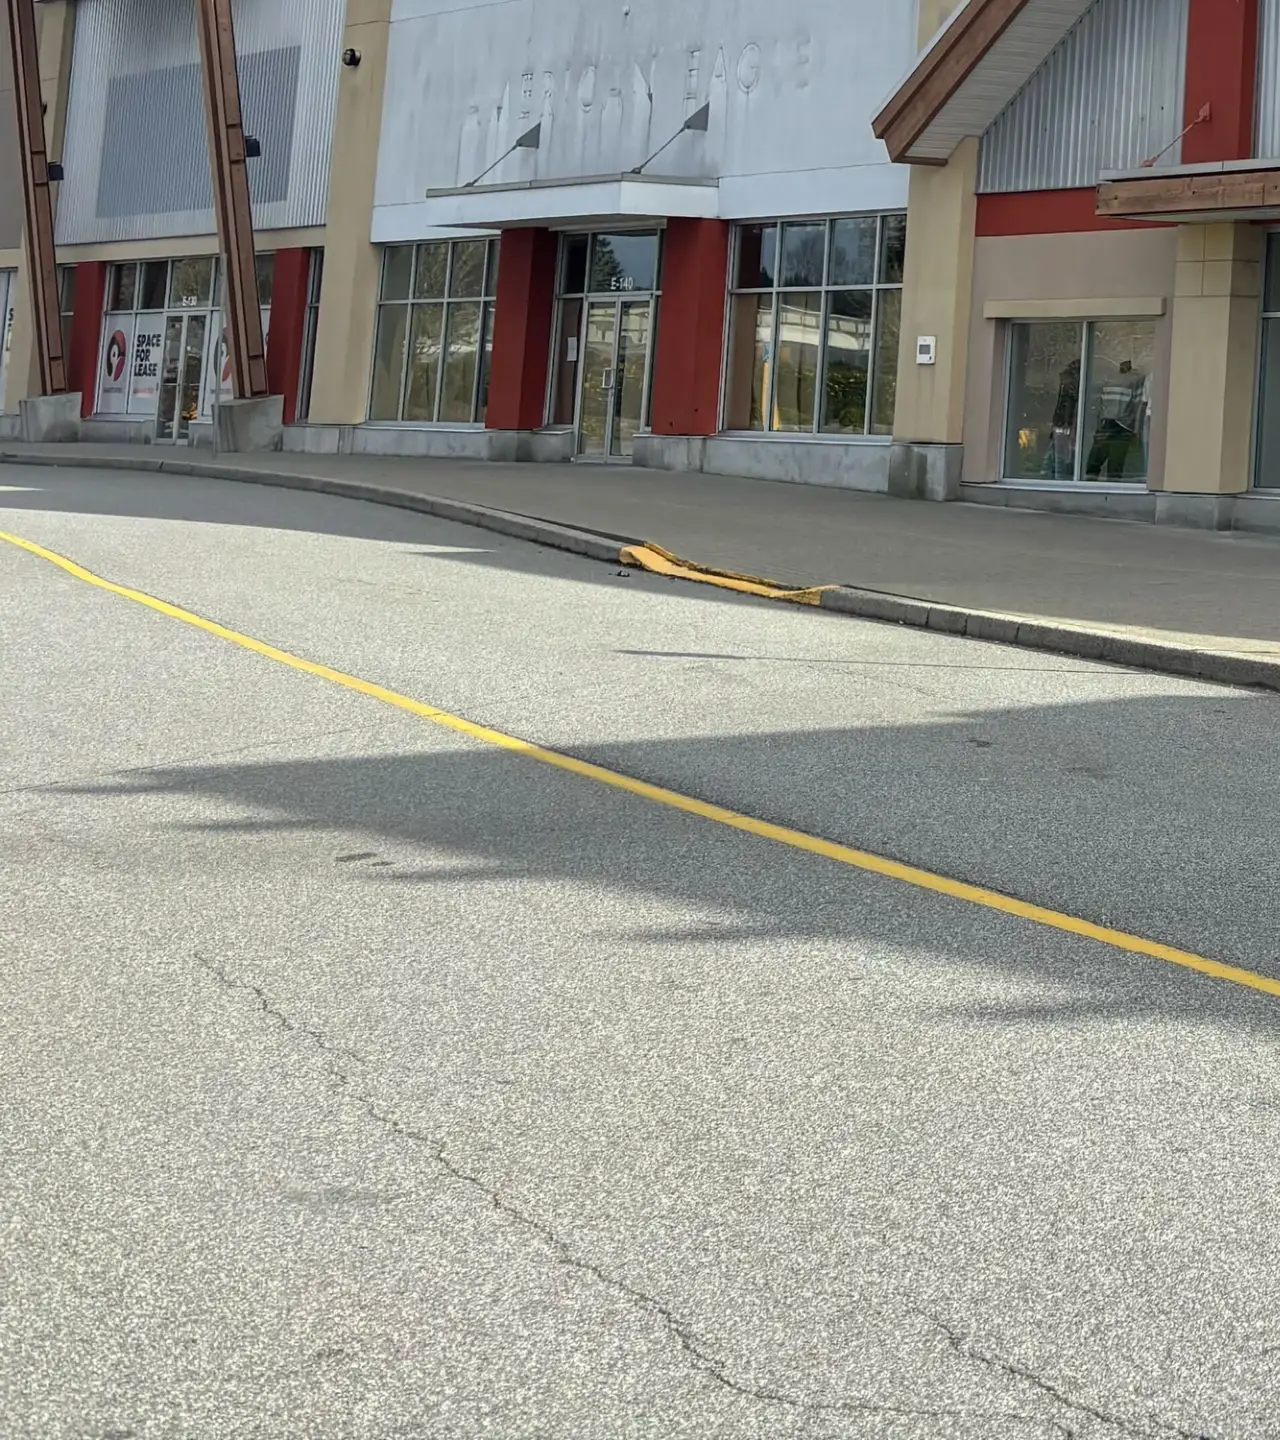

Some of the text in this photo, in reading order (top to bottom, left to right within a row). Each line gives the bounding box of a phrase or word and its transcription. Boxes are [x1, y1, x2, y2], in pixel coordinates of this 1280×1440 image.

[611, 276, 634, 290] E-140
[136, 333, 161, 348] SPACE
[135, 348, 151, 362] FOR
[133, 363, 158, 377] LEASE
